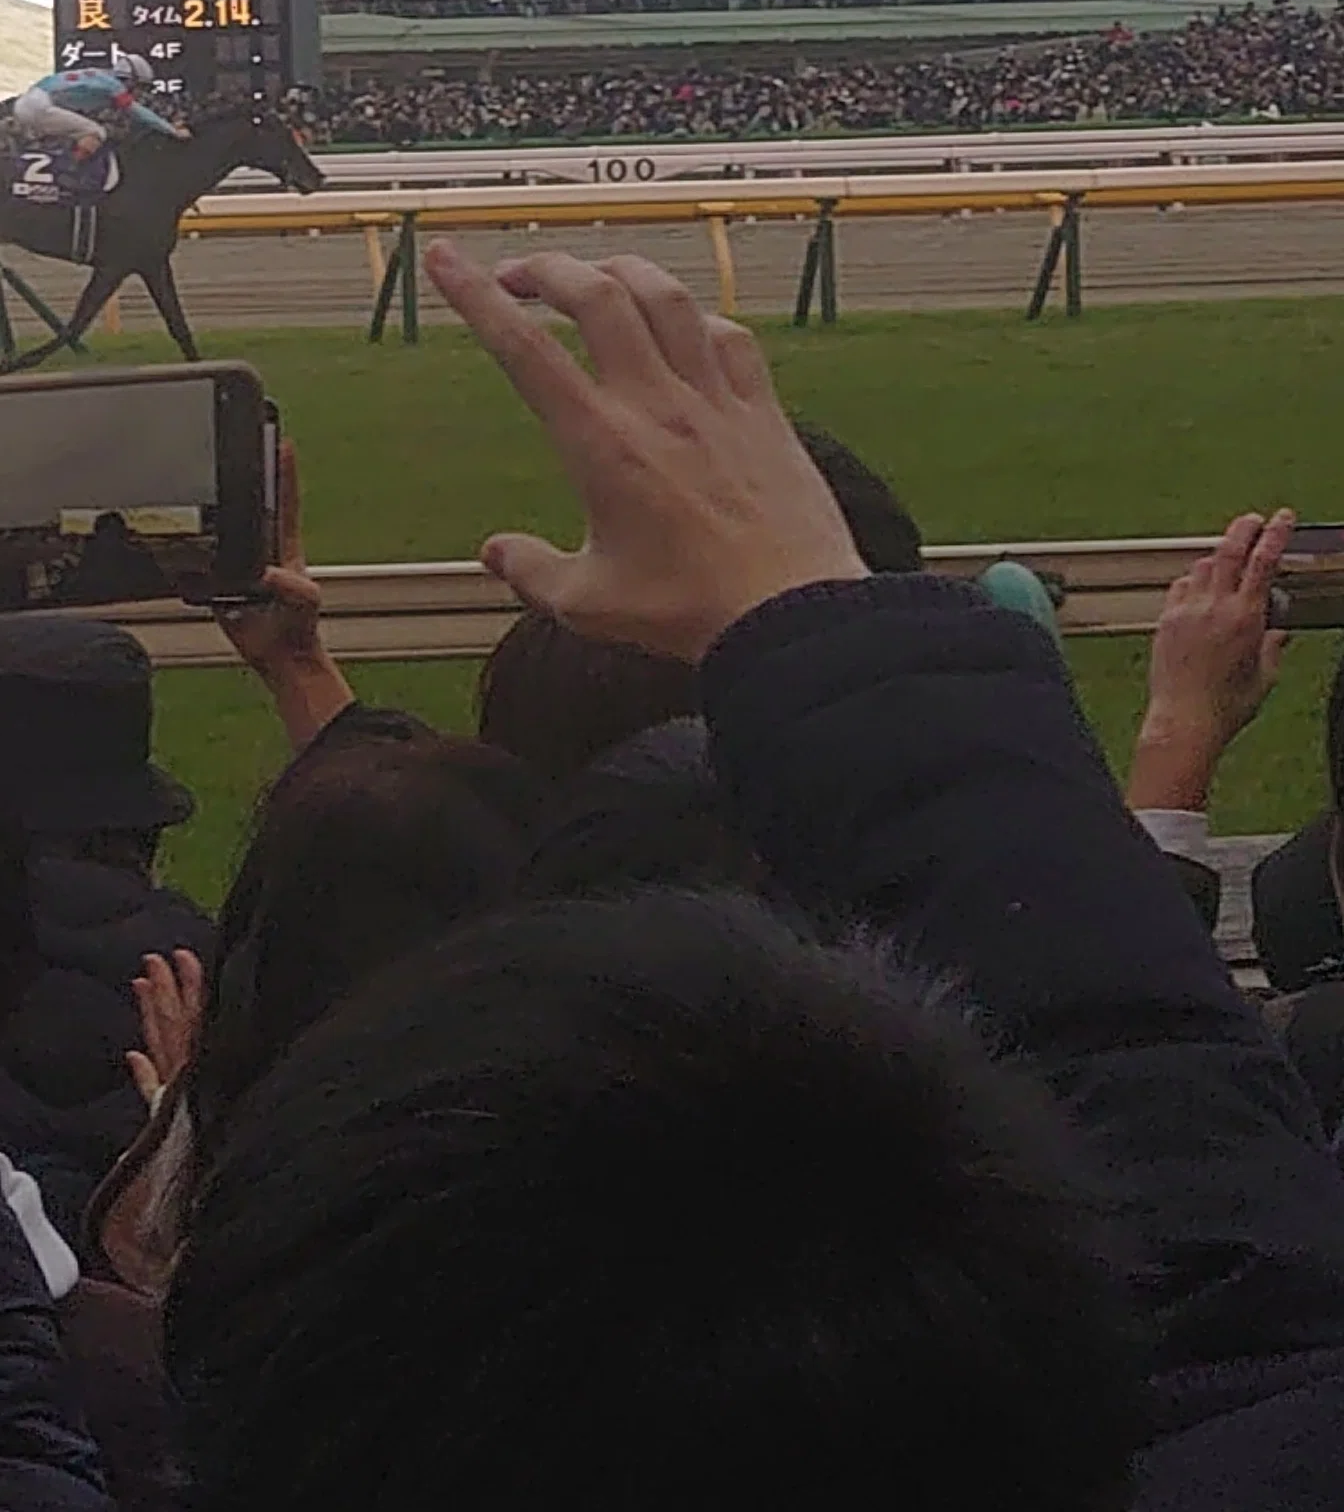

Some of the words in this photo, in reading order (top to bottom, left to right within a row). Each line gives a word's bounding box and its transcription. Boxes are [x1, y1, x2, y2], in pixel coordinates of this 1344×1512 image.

[132, 5, 183, 26] タイム
[62, 40, 128, 67] ダート
[150, 42, 183, 59] 4F
[20, 153, 54, 183] 2
[587, 157, 656, 183] 100
